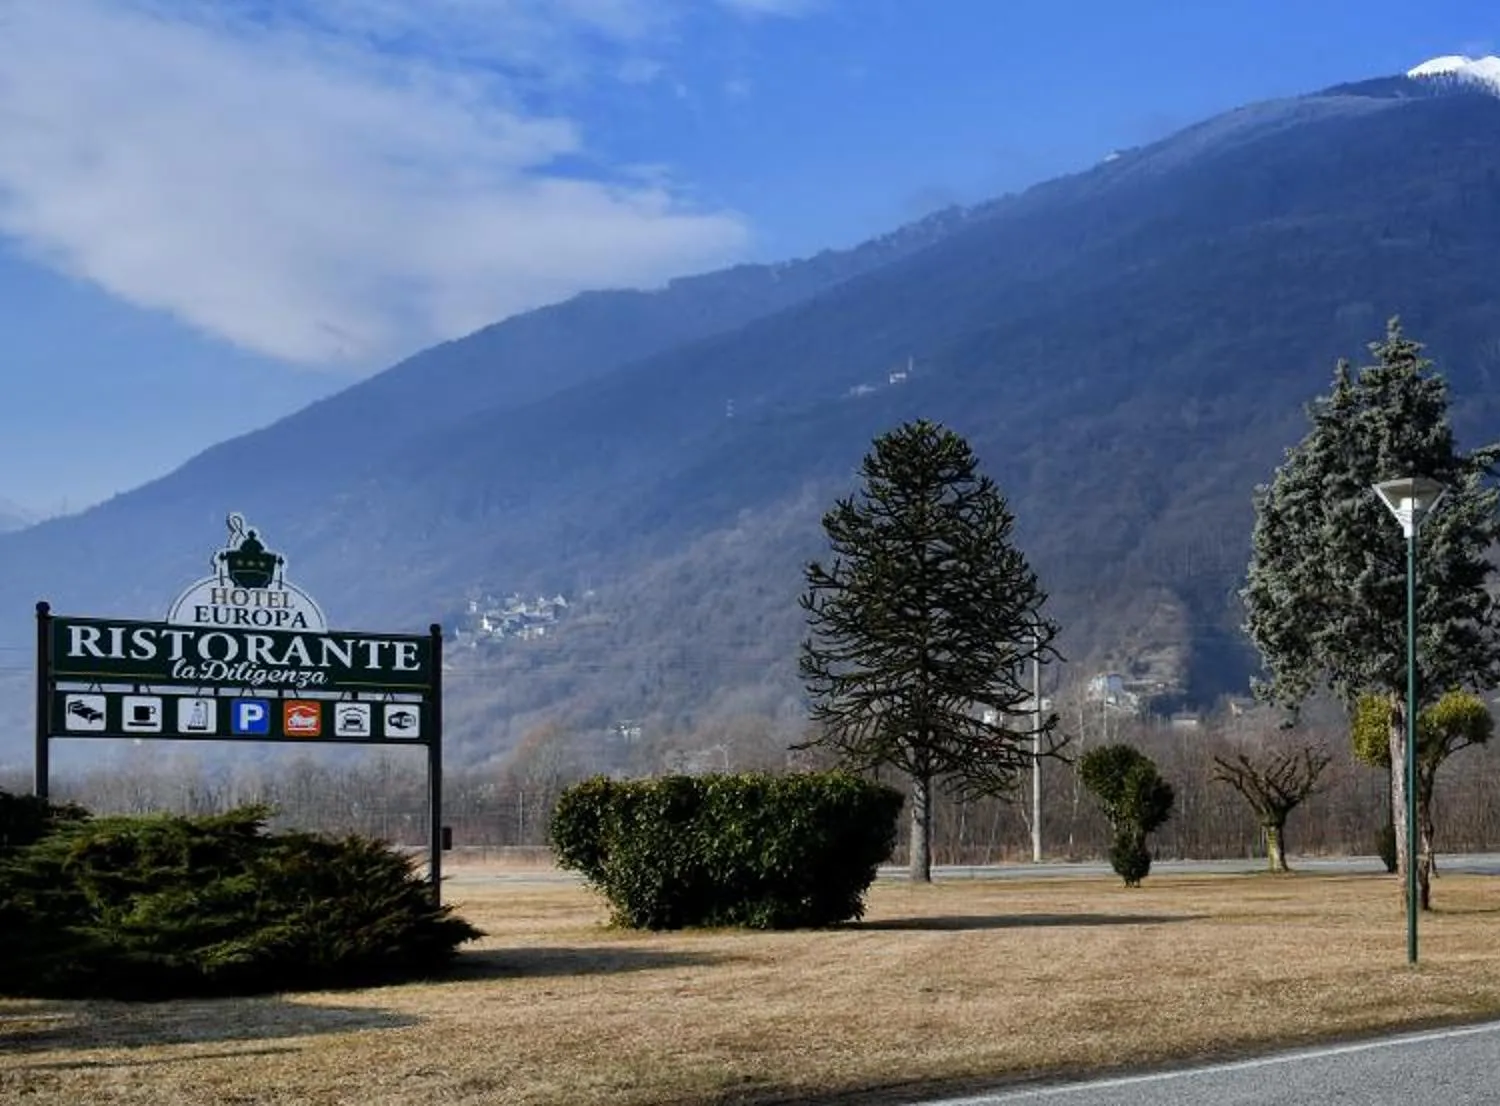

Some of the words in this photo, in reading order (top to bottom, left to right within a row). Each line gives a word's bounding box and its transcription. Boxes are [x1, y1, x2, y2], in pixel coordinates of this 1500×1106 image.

[210, 588, 294, 609] HOTEL
[194, 605, 308, 628] EUROPA
[66, 625, 421, 671] RISTORANTE
[171, 658, 199, 679] la
[200, 659, 329, 688] Diligenza
[239, 703, 264, 731] P
